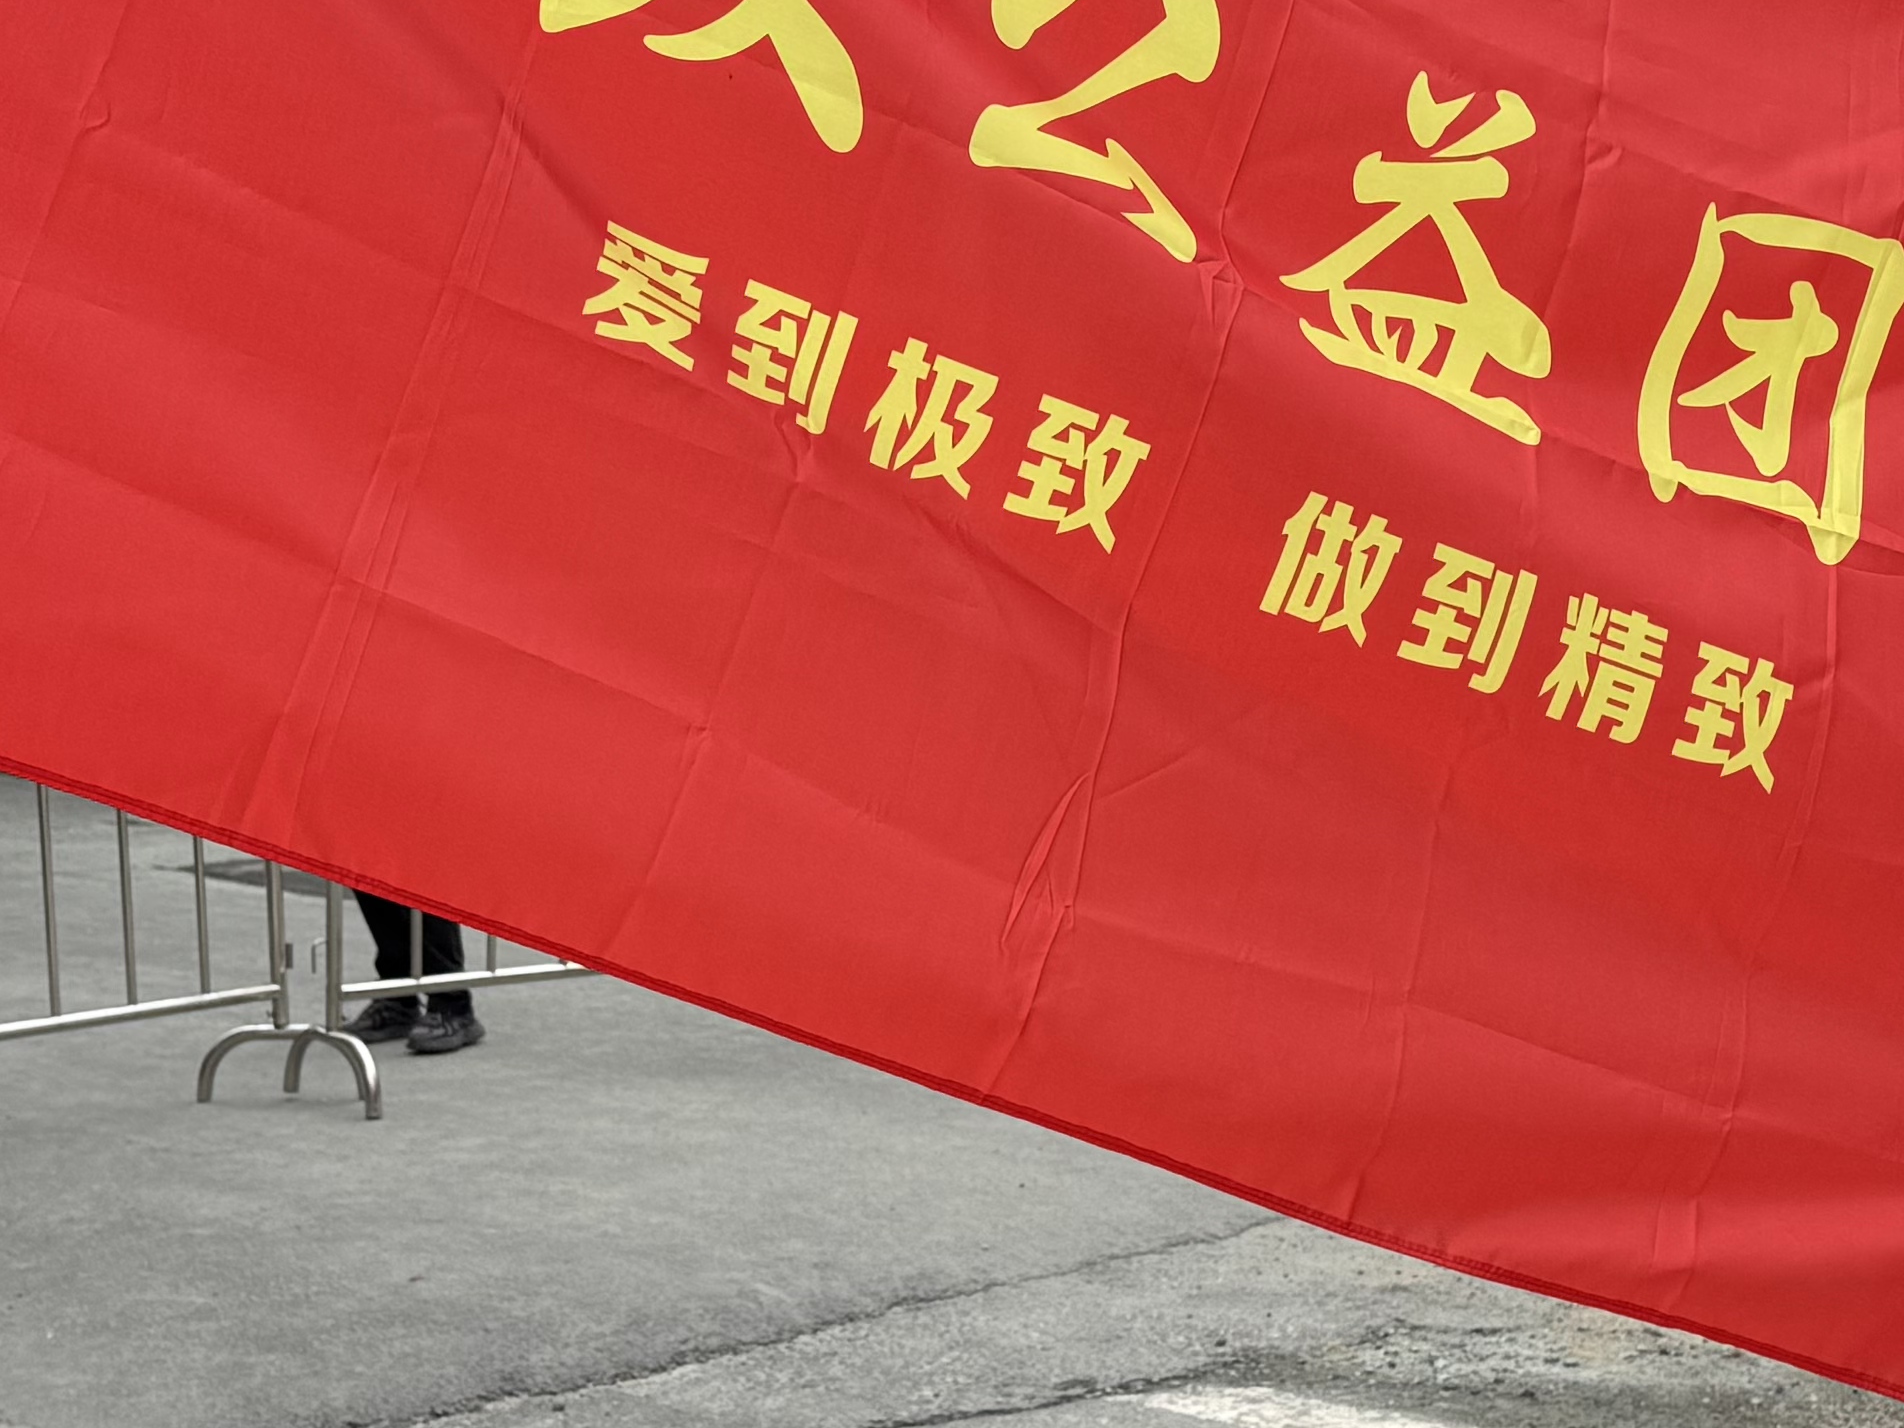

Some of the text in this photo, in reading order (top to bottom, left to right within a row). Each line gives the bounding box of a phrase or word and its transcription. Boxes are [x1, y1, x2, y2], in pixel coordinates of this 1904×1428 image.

[584, 223, 1794, 791] 爱到极致 做到精致
